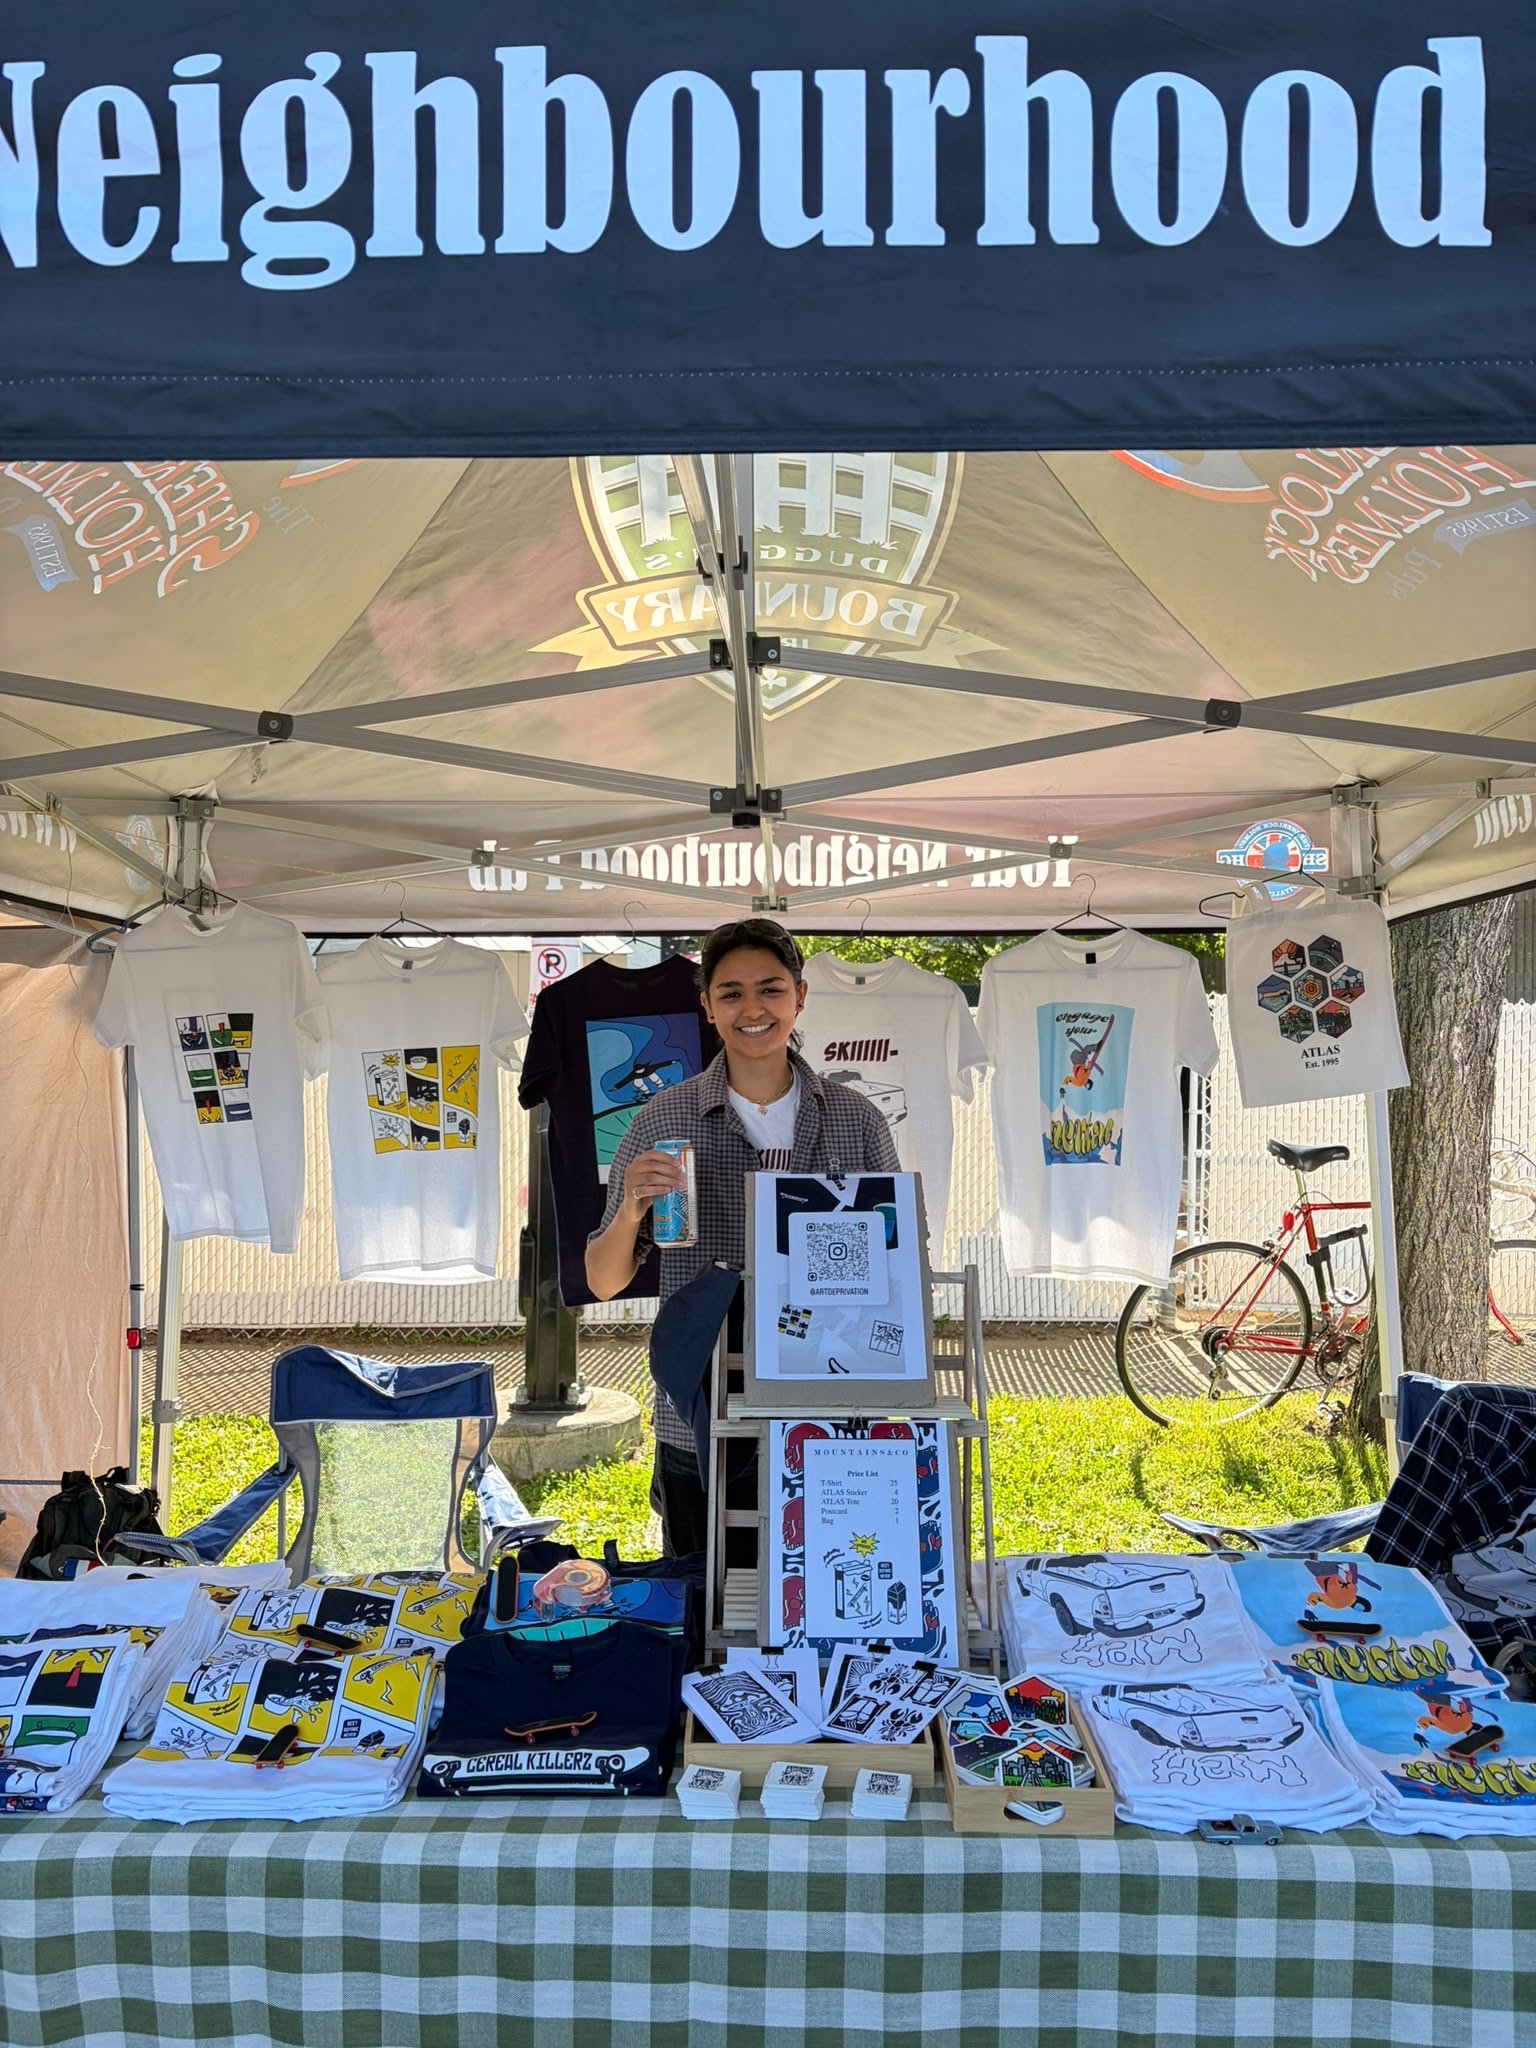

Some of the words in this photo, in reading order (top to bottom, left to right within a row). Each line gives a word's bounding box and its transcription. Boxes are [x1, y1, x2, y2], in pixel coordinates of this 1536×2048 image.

[1300, 1044, 1341, 1059] ATLAS
[1305, 1061, 1320, 1069] Est.
[1322, 1057, 1340, 1067] 1995
[809, 1287, 869, 1297] @ARTDEPRIVATION
[847, 1470, 865, 1478] Price
[866, 1470, 879, 1478] List
[821, 1479, 842, 1487] T-Shirt
[846, 1488, 868, 1496] Sticker
[846, 1498, 860, 1506] Tote
[821, 1507, 848, 1515] Postcard
[821, 1517, 834, 1525] Bag
[466, 1752, 523, 1774] CEREAL
[526, 1751, 593, 1771] KILLERZ
